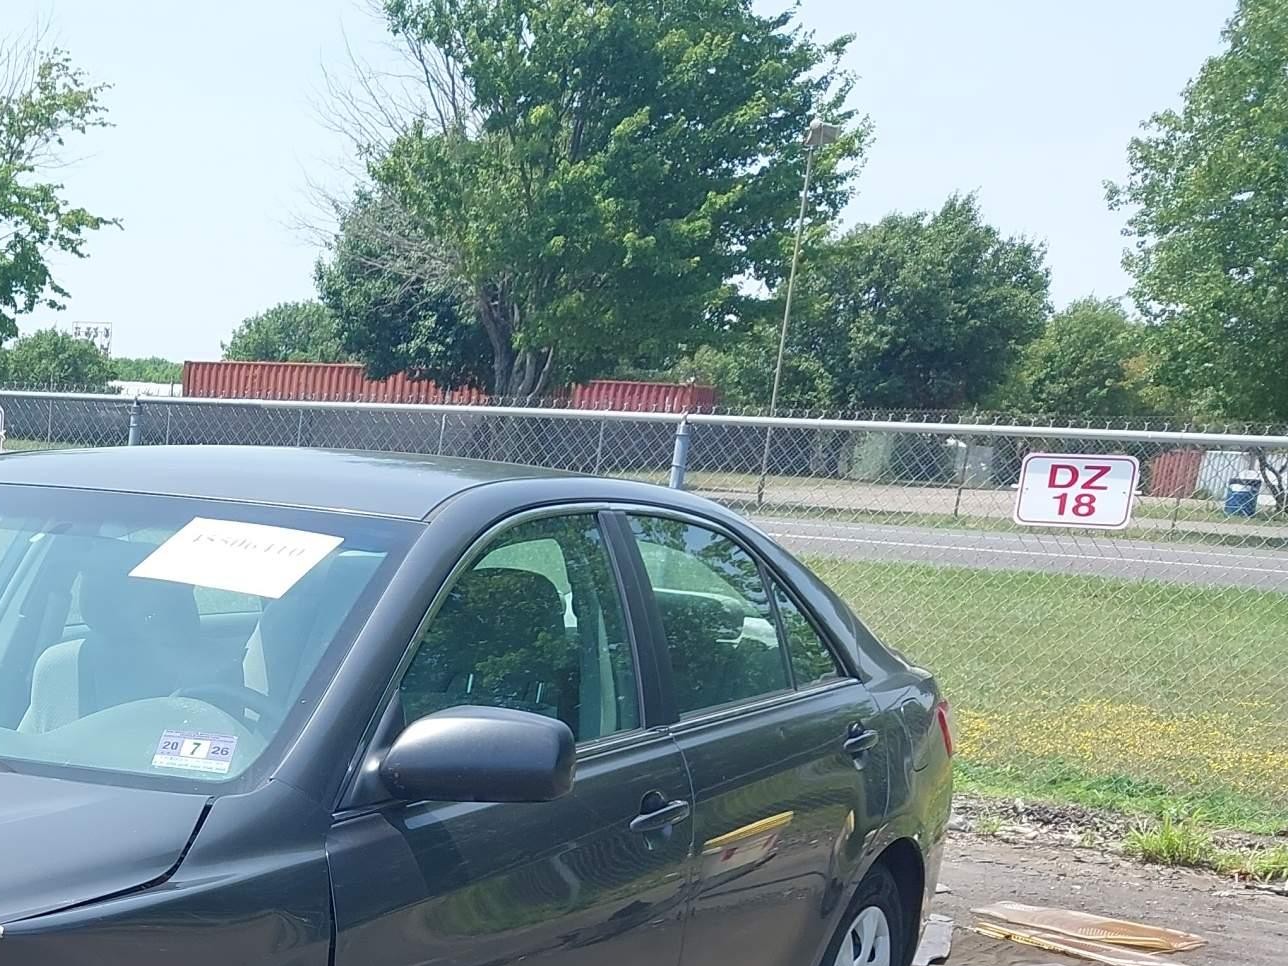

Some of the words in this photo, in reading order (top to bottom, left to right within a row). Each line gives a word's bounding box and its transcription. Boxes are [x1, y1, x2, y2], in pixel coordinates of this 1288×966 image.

[1047, 463, 1112, 491] DZ
[1051, 492, 1097, 518] 18
[162, 740, 179, 751] 20
[189, 742, 202, 756] 7
[211, 746, 230, 756] 26
